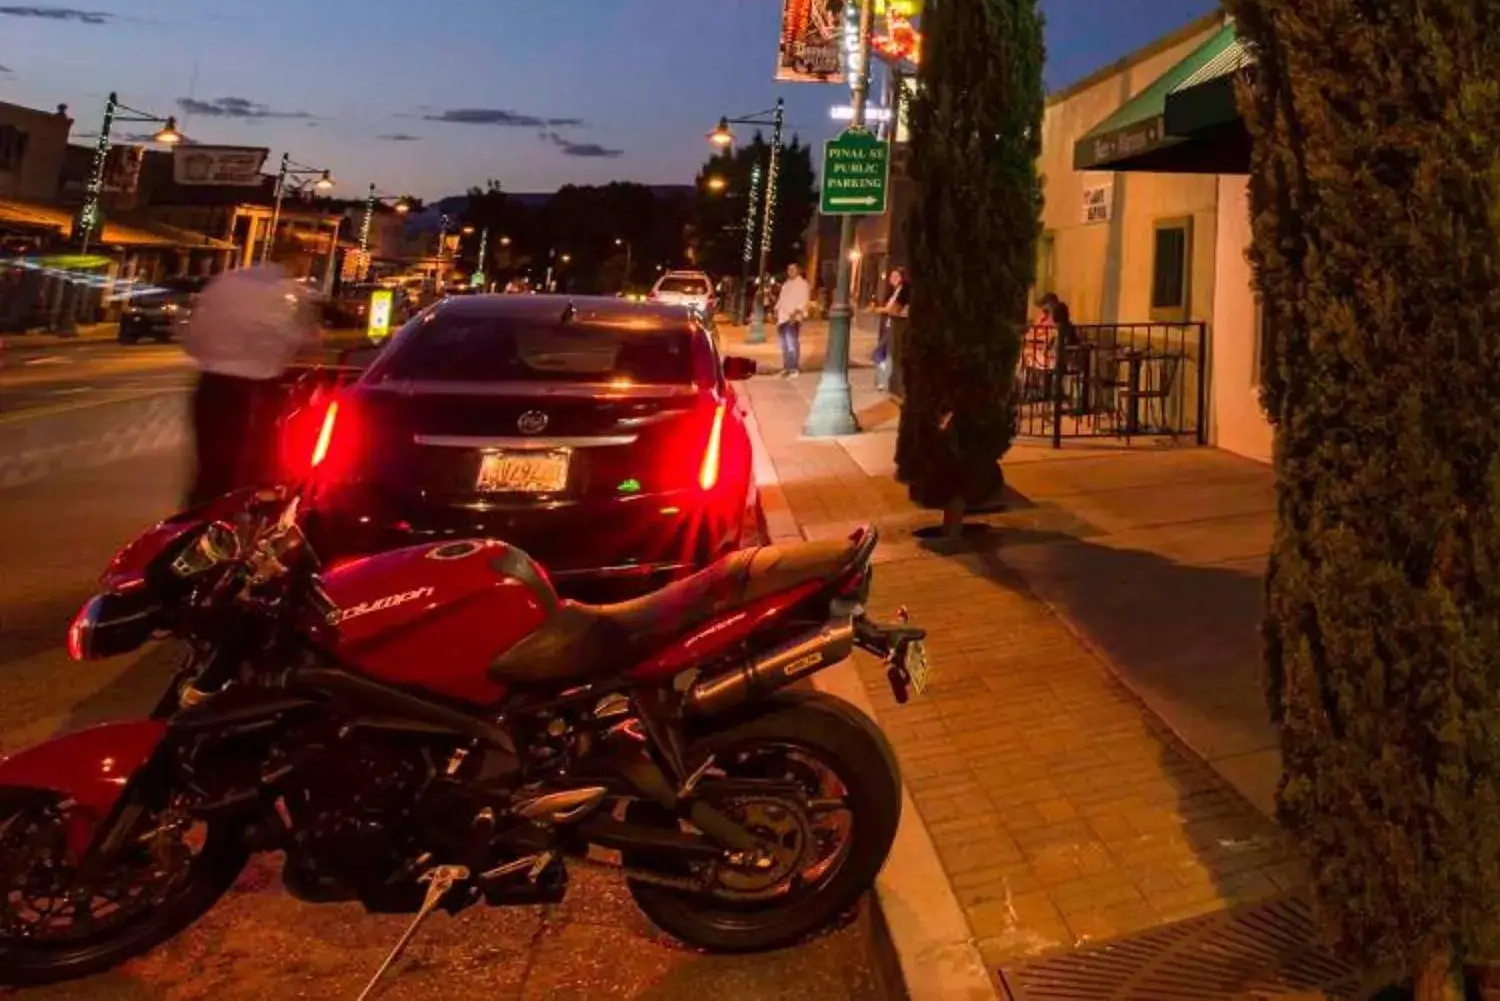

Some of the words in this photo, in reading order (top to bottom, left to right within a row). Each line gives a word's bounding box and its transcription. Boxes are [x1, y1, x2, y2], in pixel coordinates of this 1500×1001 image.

[828, 148, 866, 159] PINAL
[833, 162, 879, 174] PUBLIC
[827, 178, 882, 189] PARKING
